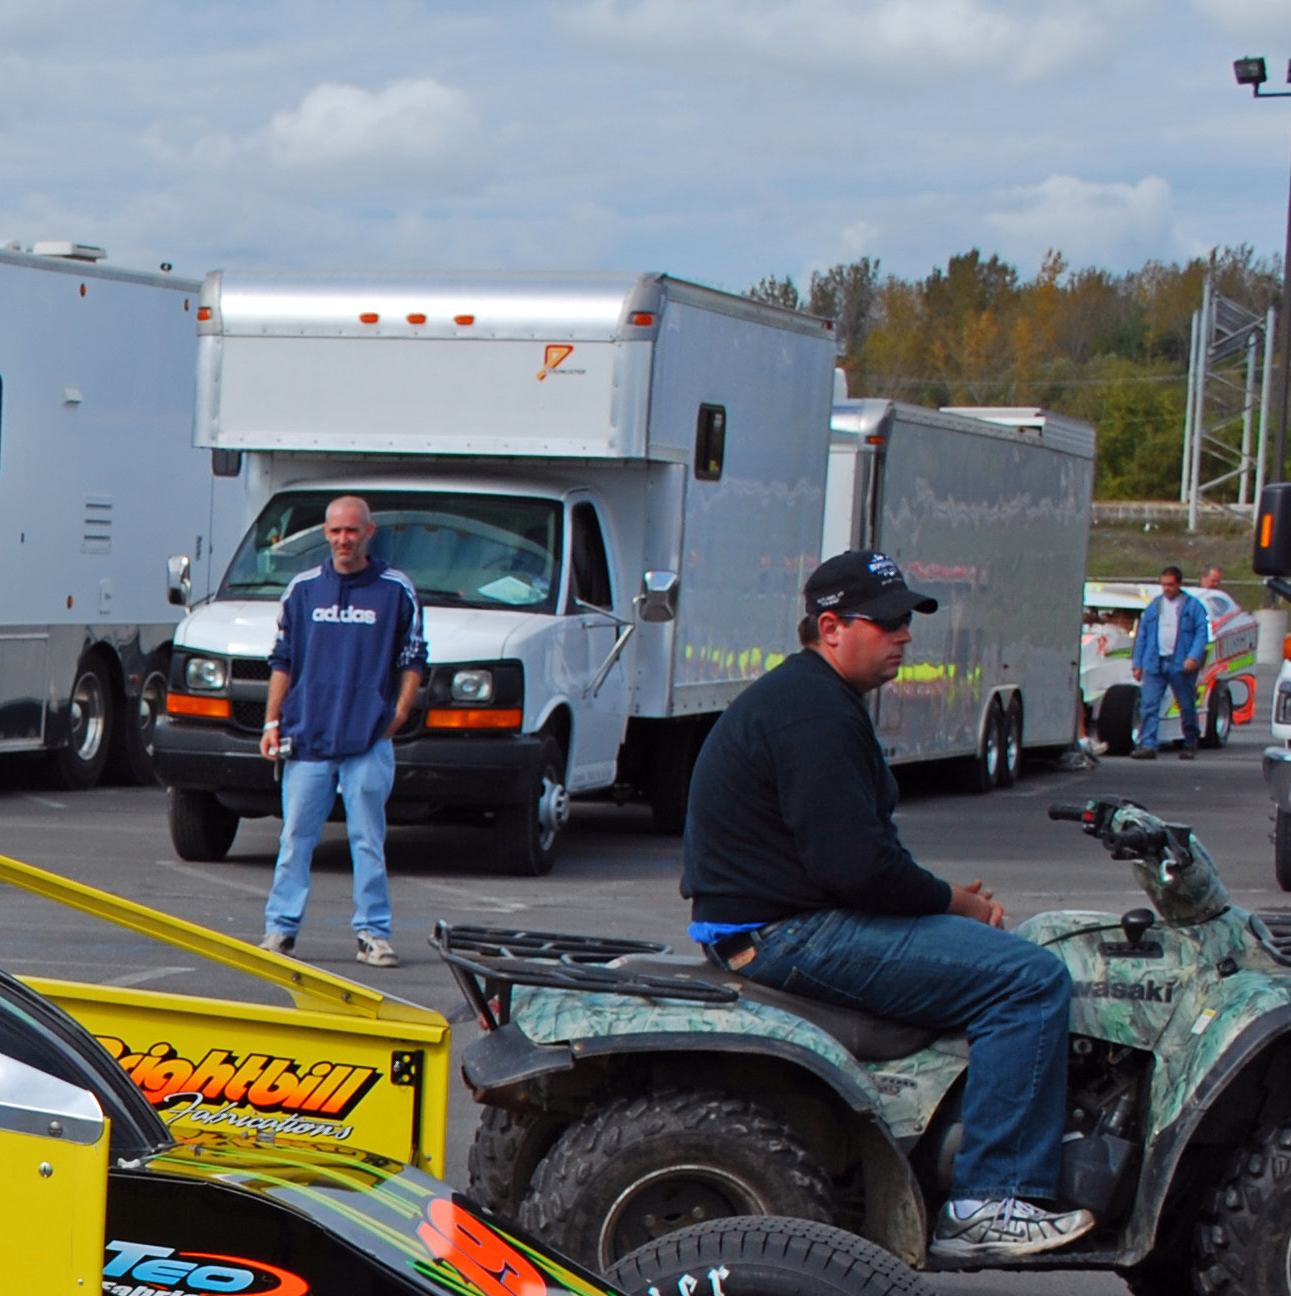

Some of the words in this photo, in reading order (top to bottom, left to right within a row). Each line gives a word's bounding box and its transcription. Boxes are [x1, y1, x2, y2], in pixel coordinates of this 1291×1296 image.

[312, 604, 376, 625] addas
[1071, 979, 1177, 1003] wasaki
[94, 1035, 384, 1120] rightbill
[163, 1091, 355, 1141] Fabrications
